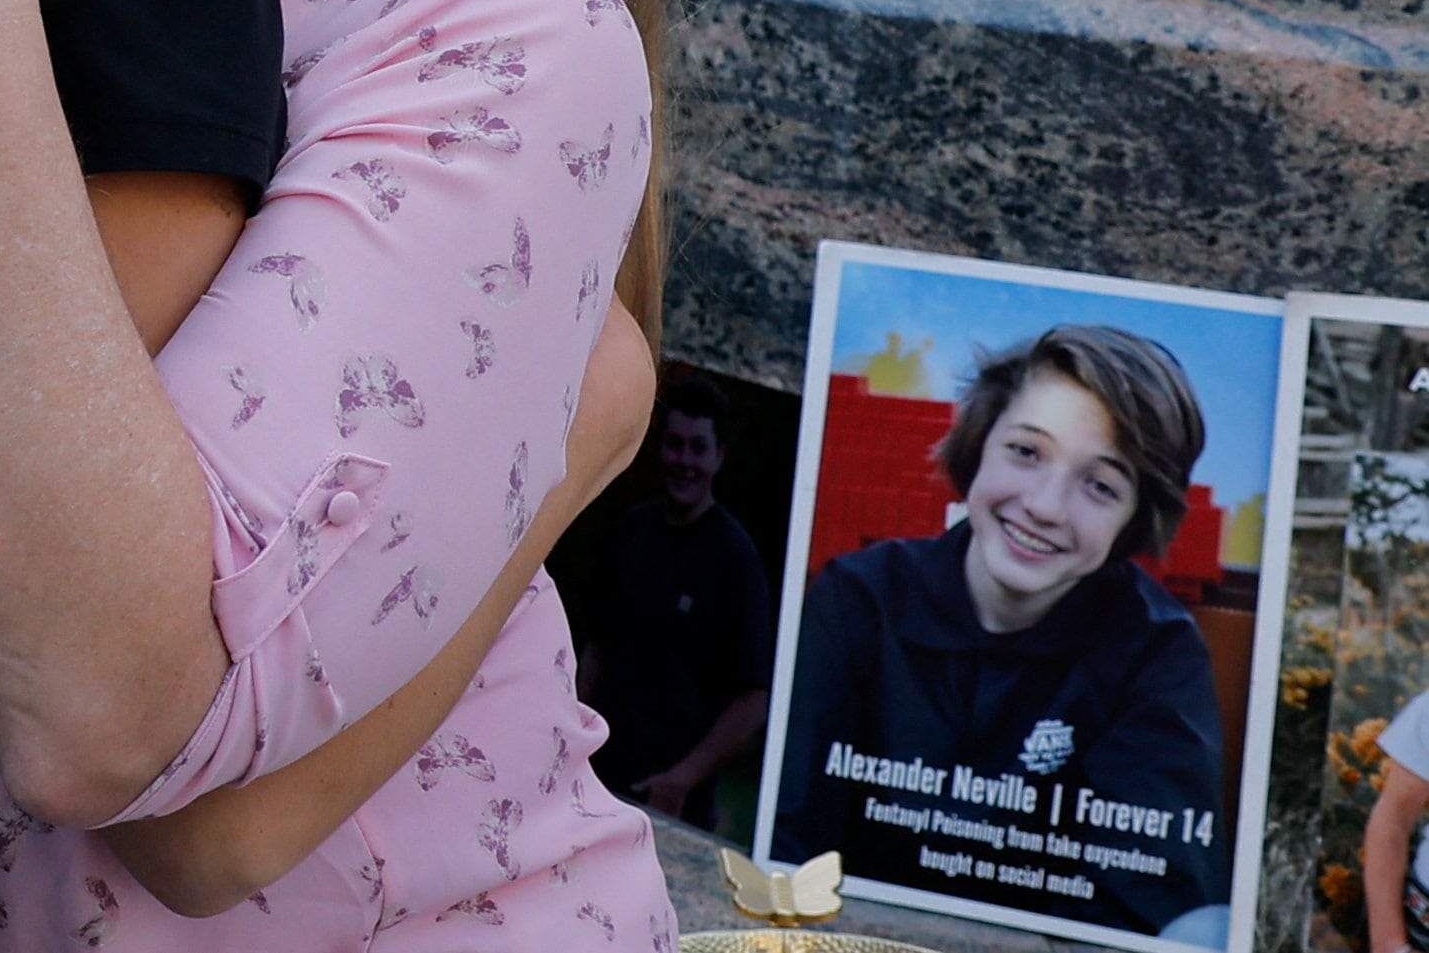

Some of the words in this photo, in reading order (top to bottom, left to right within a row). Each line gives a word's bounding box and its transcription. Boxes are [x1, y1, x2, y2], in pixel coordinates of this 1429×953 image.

[825, 741, 948, 796] Alexander
[951, 764, 1037, 813] Neville
[1076, 787, 1174, 839] Forever
[1181, 807, 1214, 847] 14
[865, 797, 930, 834] Fentanyl
[931, 809, 1005, 849] Poisoning
[1007, 824, 1044, 852] from
[1046, 832, 1082, 860] fake
[1083, 843, 1167, 876] oxycodone
[919, 845, 973, 877] bought
[974, 860, 995, 880] on
[997, 864, 1045, 890] social
[1046, 874, 1095, 900] media
